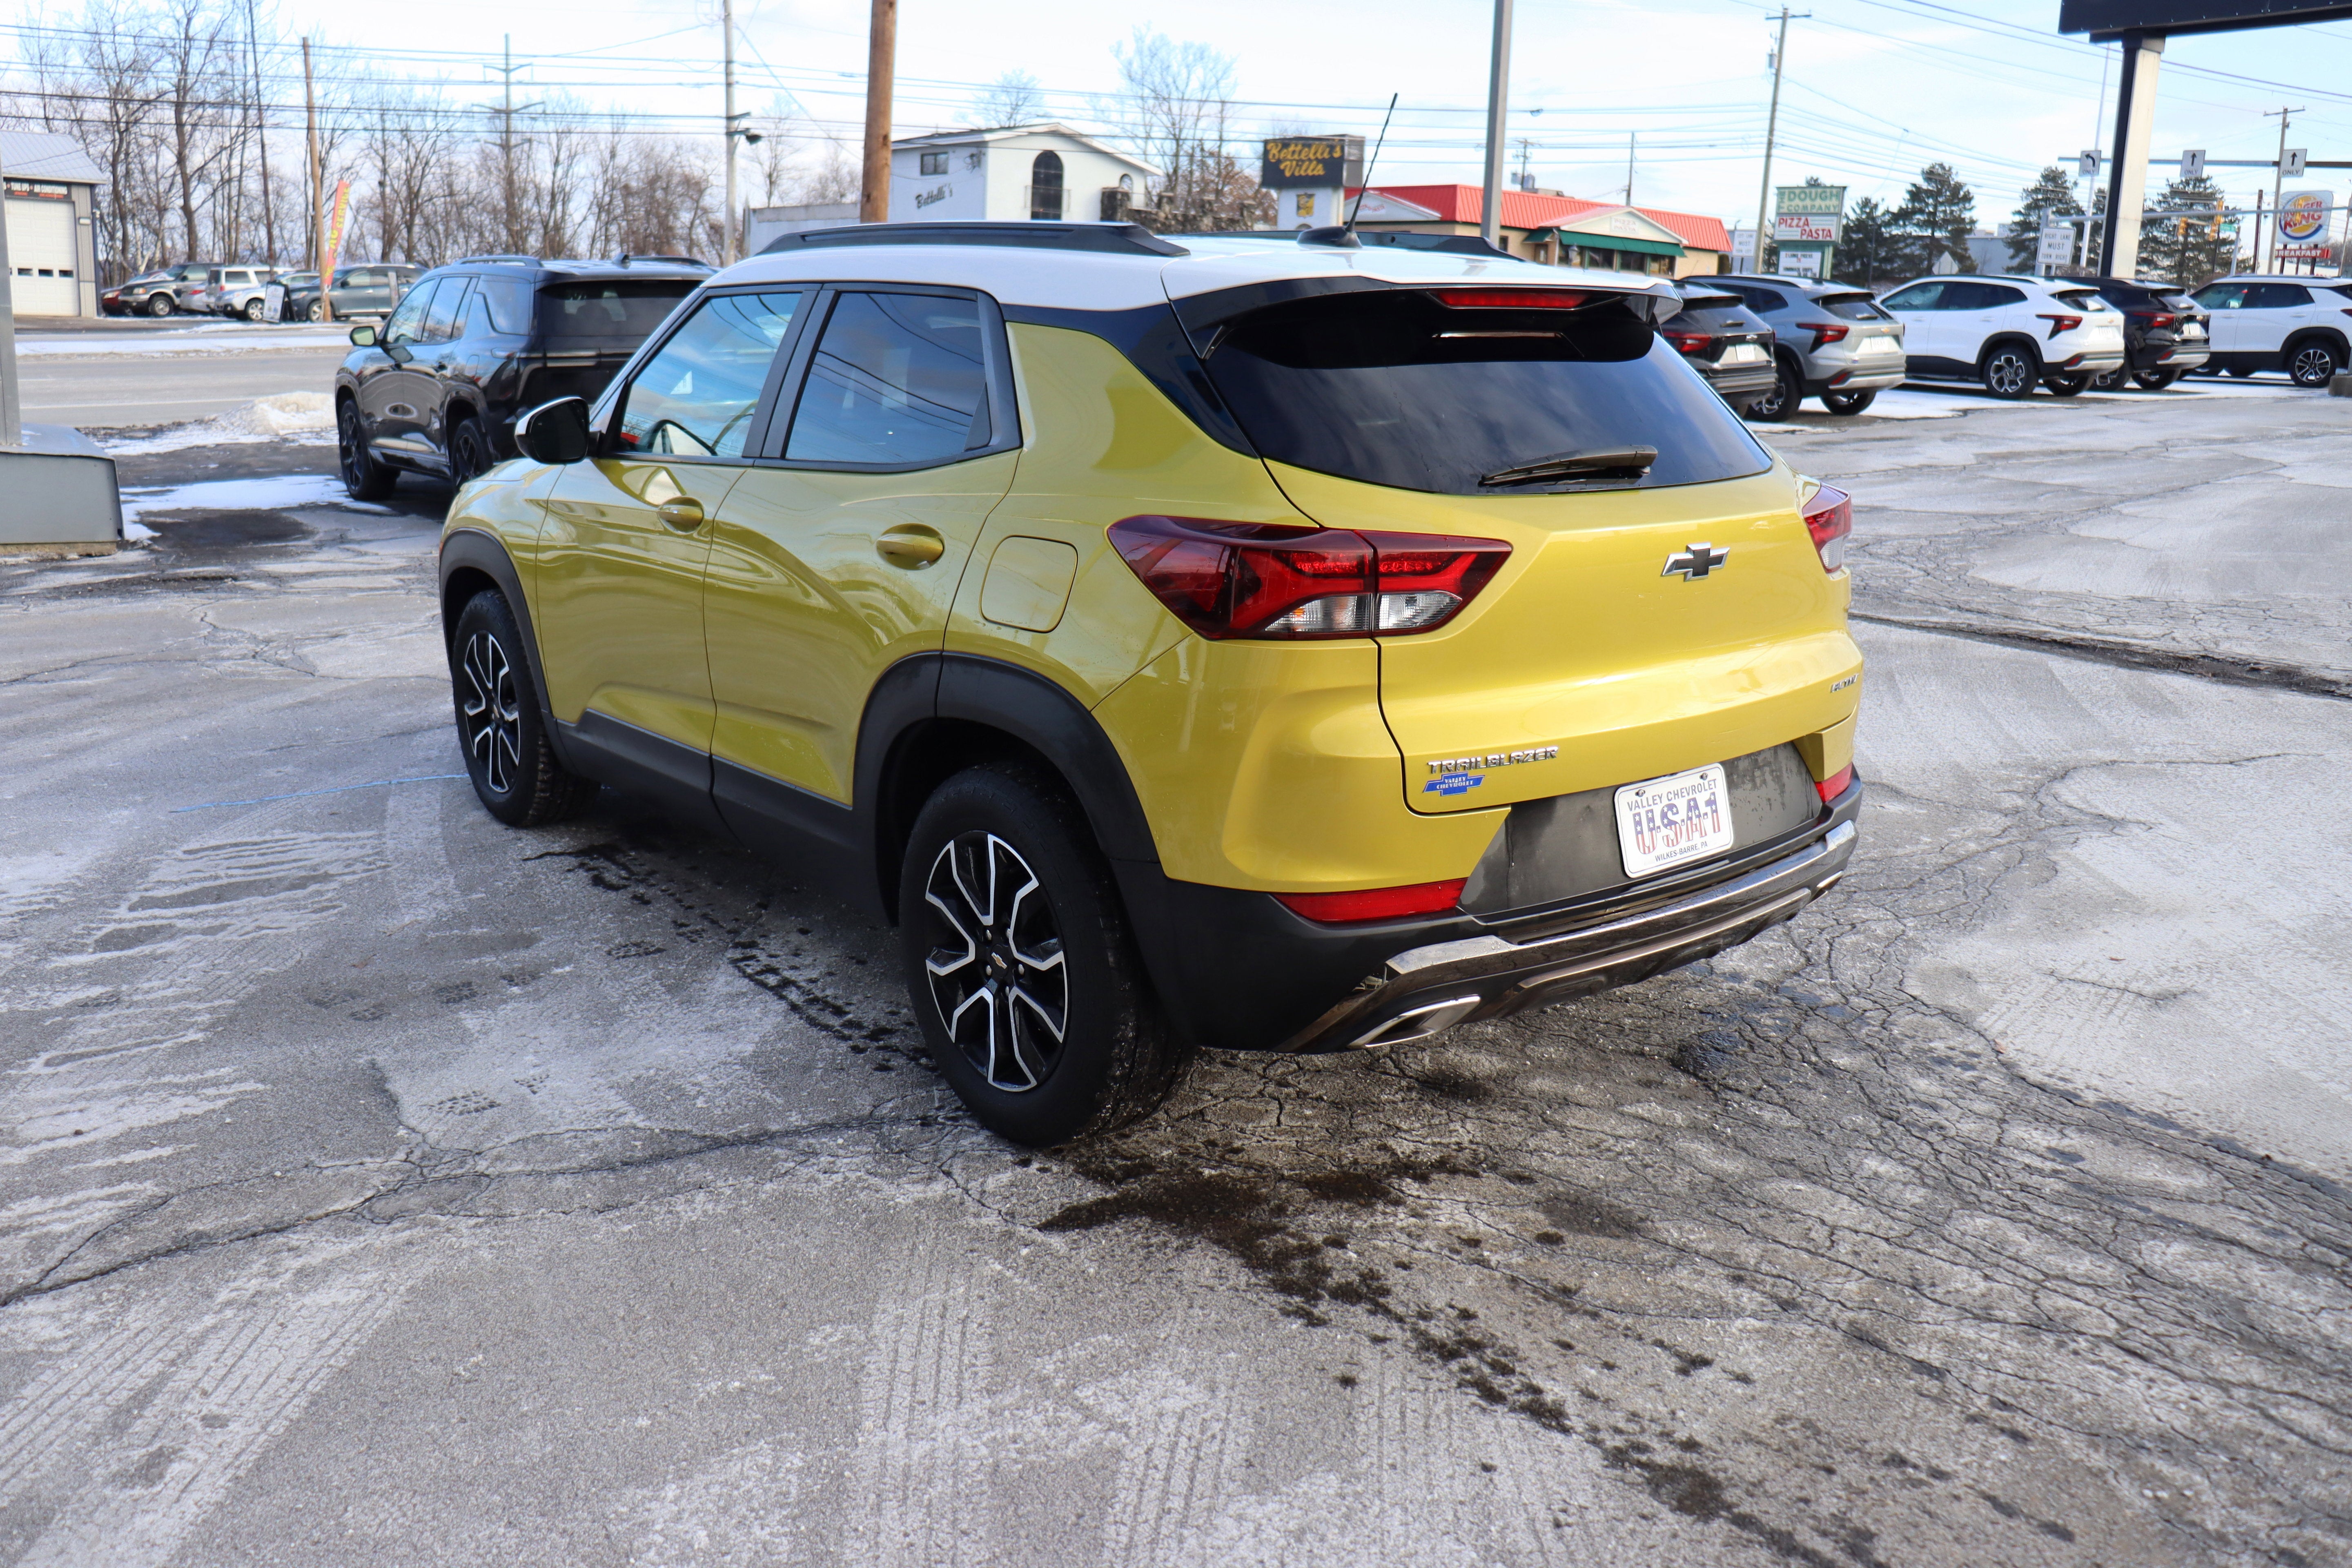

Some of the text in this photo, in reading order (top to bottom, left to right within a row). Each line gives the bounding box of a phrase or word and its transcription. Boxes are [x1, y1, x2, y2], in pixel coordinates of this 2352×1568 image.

[1267, 139, 1342, 162] Bettelli's
[1279, 160, 1325, 177] Villa
[1788, 190, 1840, 202] DOUGH
[1778, 217, 1809, 228] PIZZA
[1800, 229, 1832, 239] PASTA
[2047, 242, 2065, 250] MUST
[2055, 254, 2067, 262] RIGHT
[1428, 746, 1559, 774] TRAILBLAZER
[1437, 780, 1473, 789] CHEVROLET
[1627, 779, 1717, 812] VALLEY CHEVROLET
[1655, 845, 1699, 862] WILKES-BARRE,
